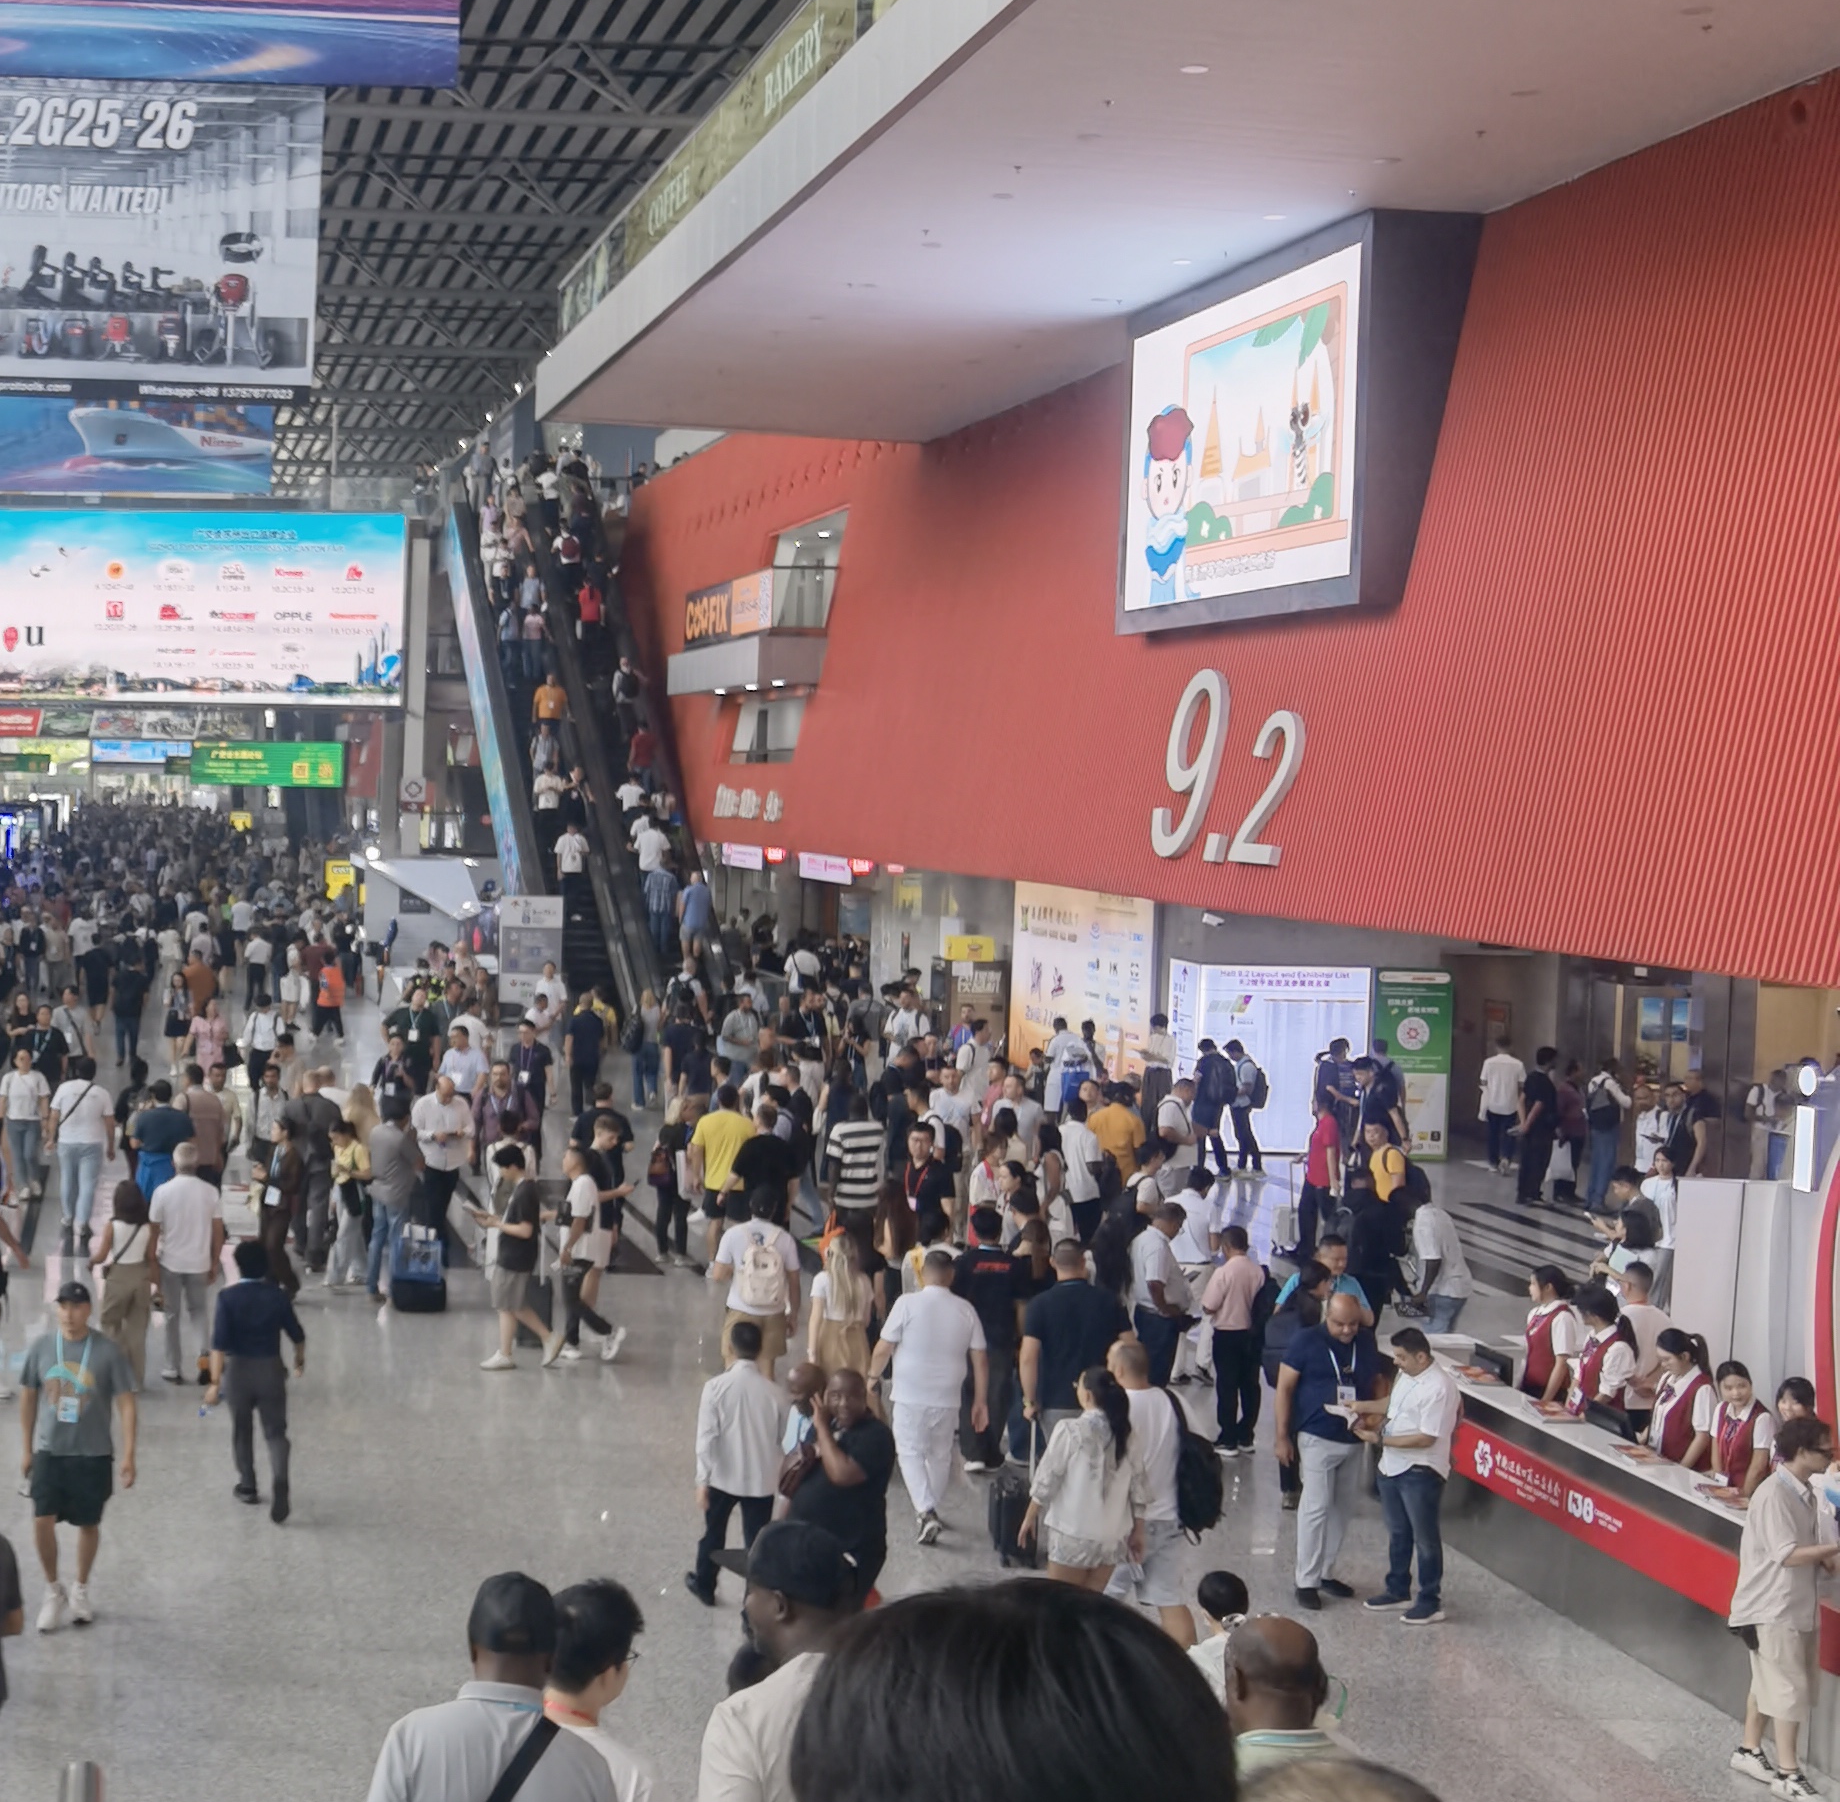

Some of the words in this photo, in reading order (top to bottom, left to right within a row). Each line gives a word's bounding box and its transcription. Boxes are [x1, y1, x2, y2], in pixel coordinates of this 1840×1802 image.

[764, 14, 825, 118] BAKERY
[66, 185, 170, 216] WANTED!
[647, 165, 690, 237] COFFEE
[274, 611, 313, 622] OPPLE
[1151, 667, 1307, 867] 9.2
